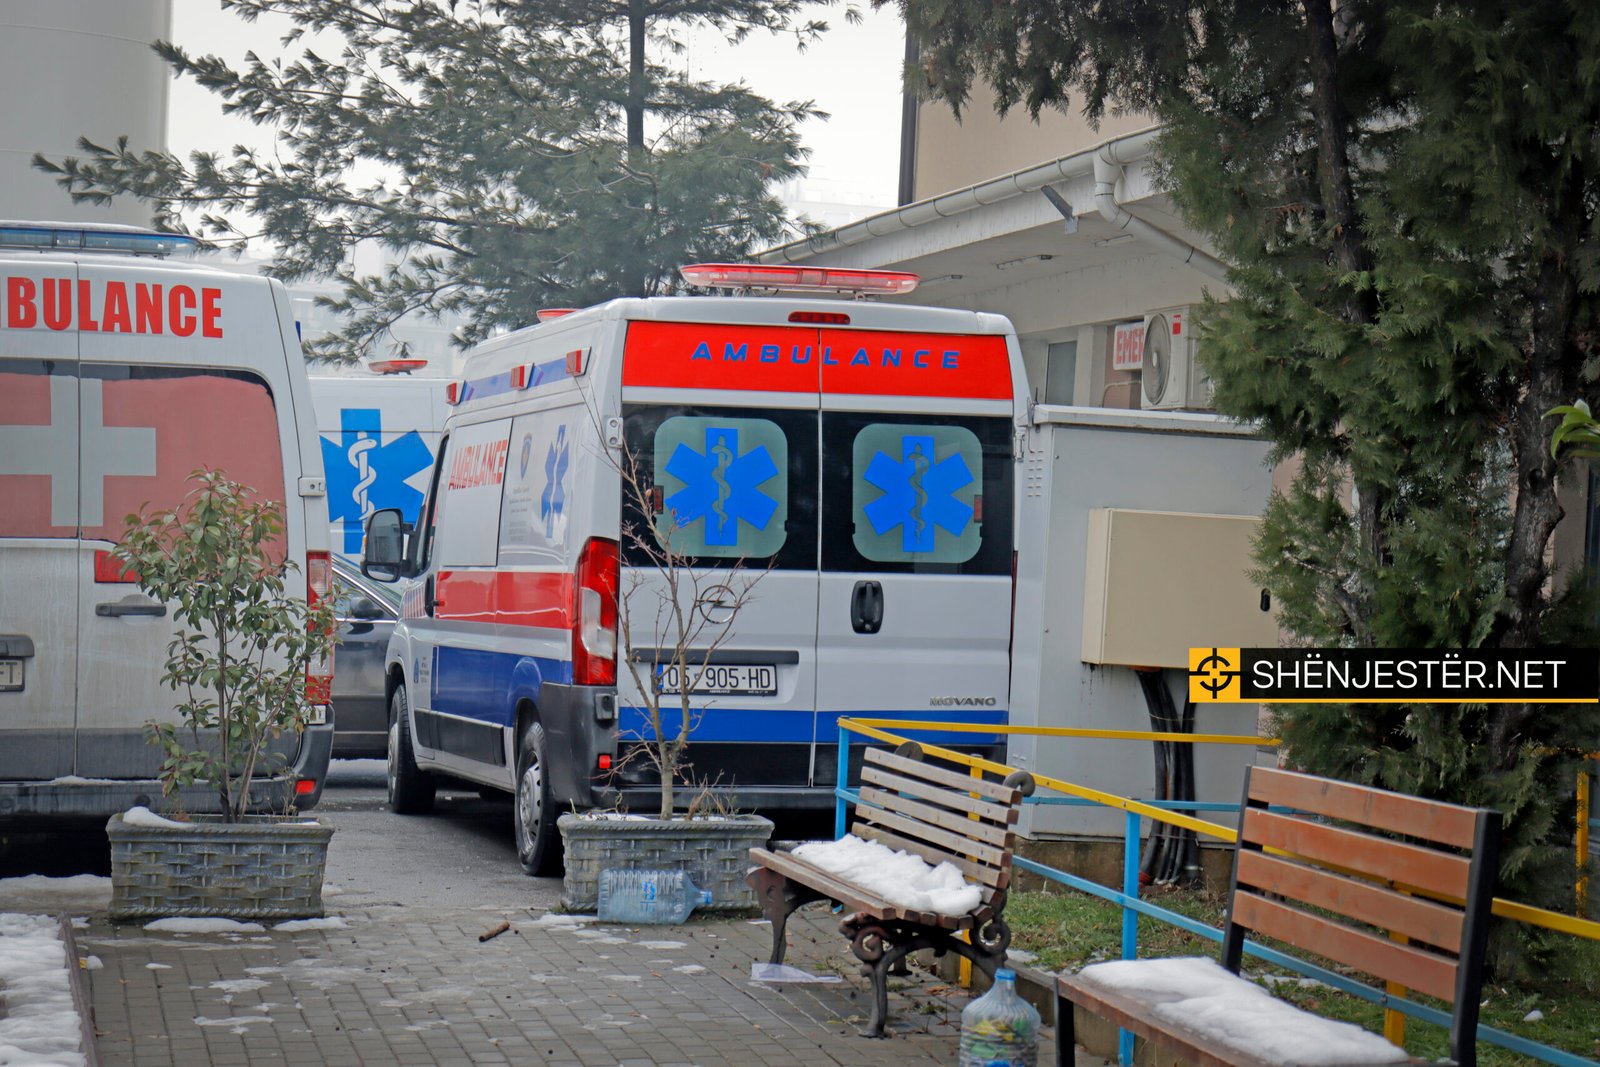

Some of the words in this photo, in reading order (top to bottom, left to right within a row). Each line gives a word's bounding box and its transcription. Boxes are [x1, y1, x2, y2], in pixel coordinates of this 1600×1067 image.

[0, 276, 224, 339] BULANCE
[691, 341, 960, 370] AMBULANCE
[929, 696, 996, 706] MOVANO
